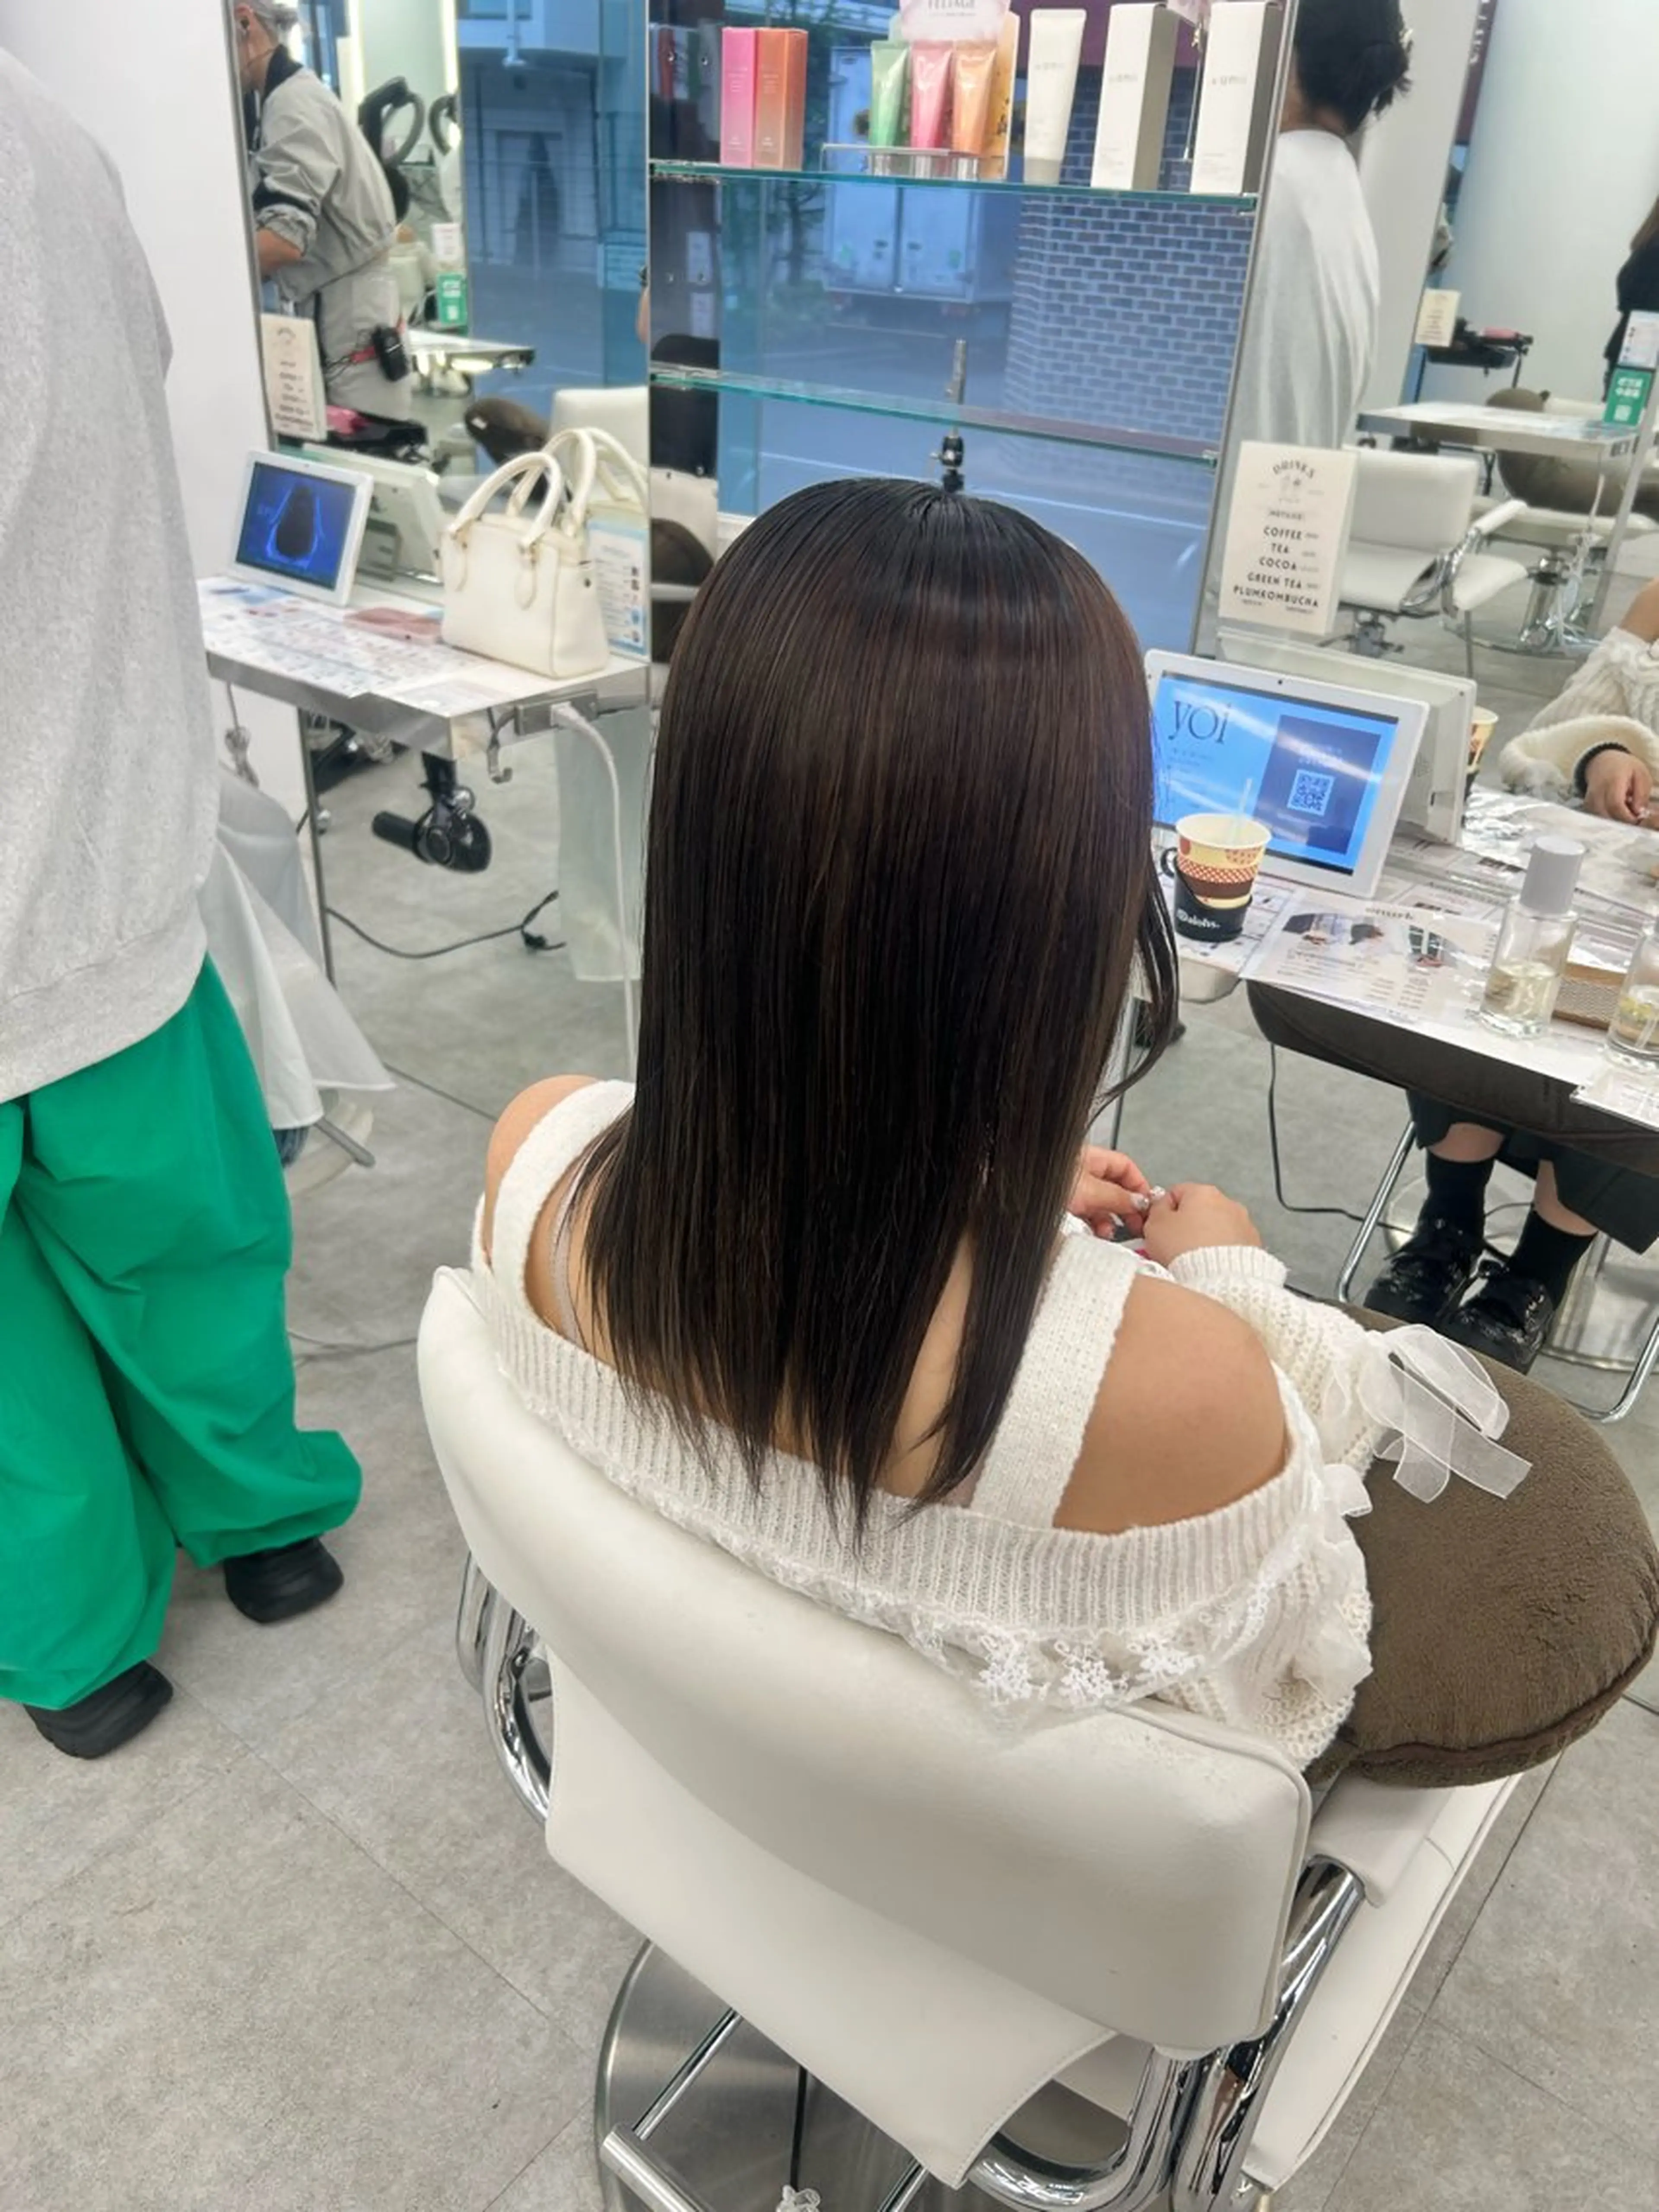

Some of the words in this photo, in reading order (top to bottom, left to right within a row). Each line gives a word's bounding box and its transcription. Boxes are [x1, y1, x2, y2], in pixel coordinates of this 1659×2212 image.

[1263, 525, 1302, 540] COFFEE
[1271, 542, 1289, 553] TEA
[1259, 556, 1297, 571] COCOA
[1247, 572, 1280, 584] GREEN
[1284, 577, 1302, 588] TEA
